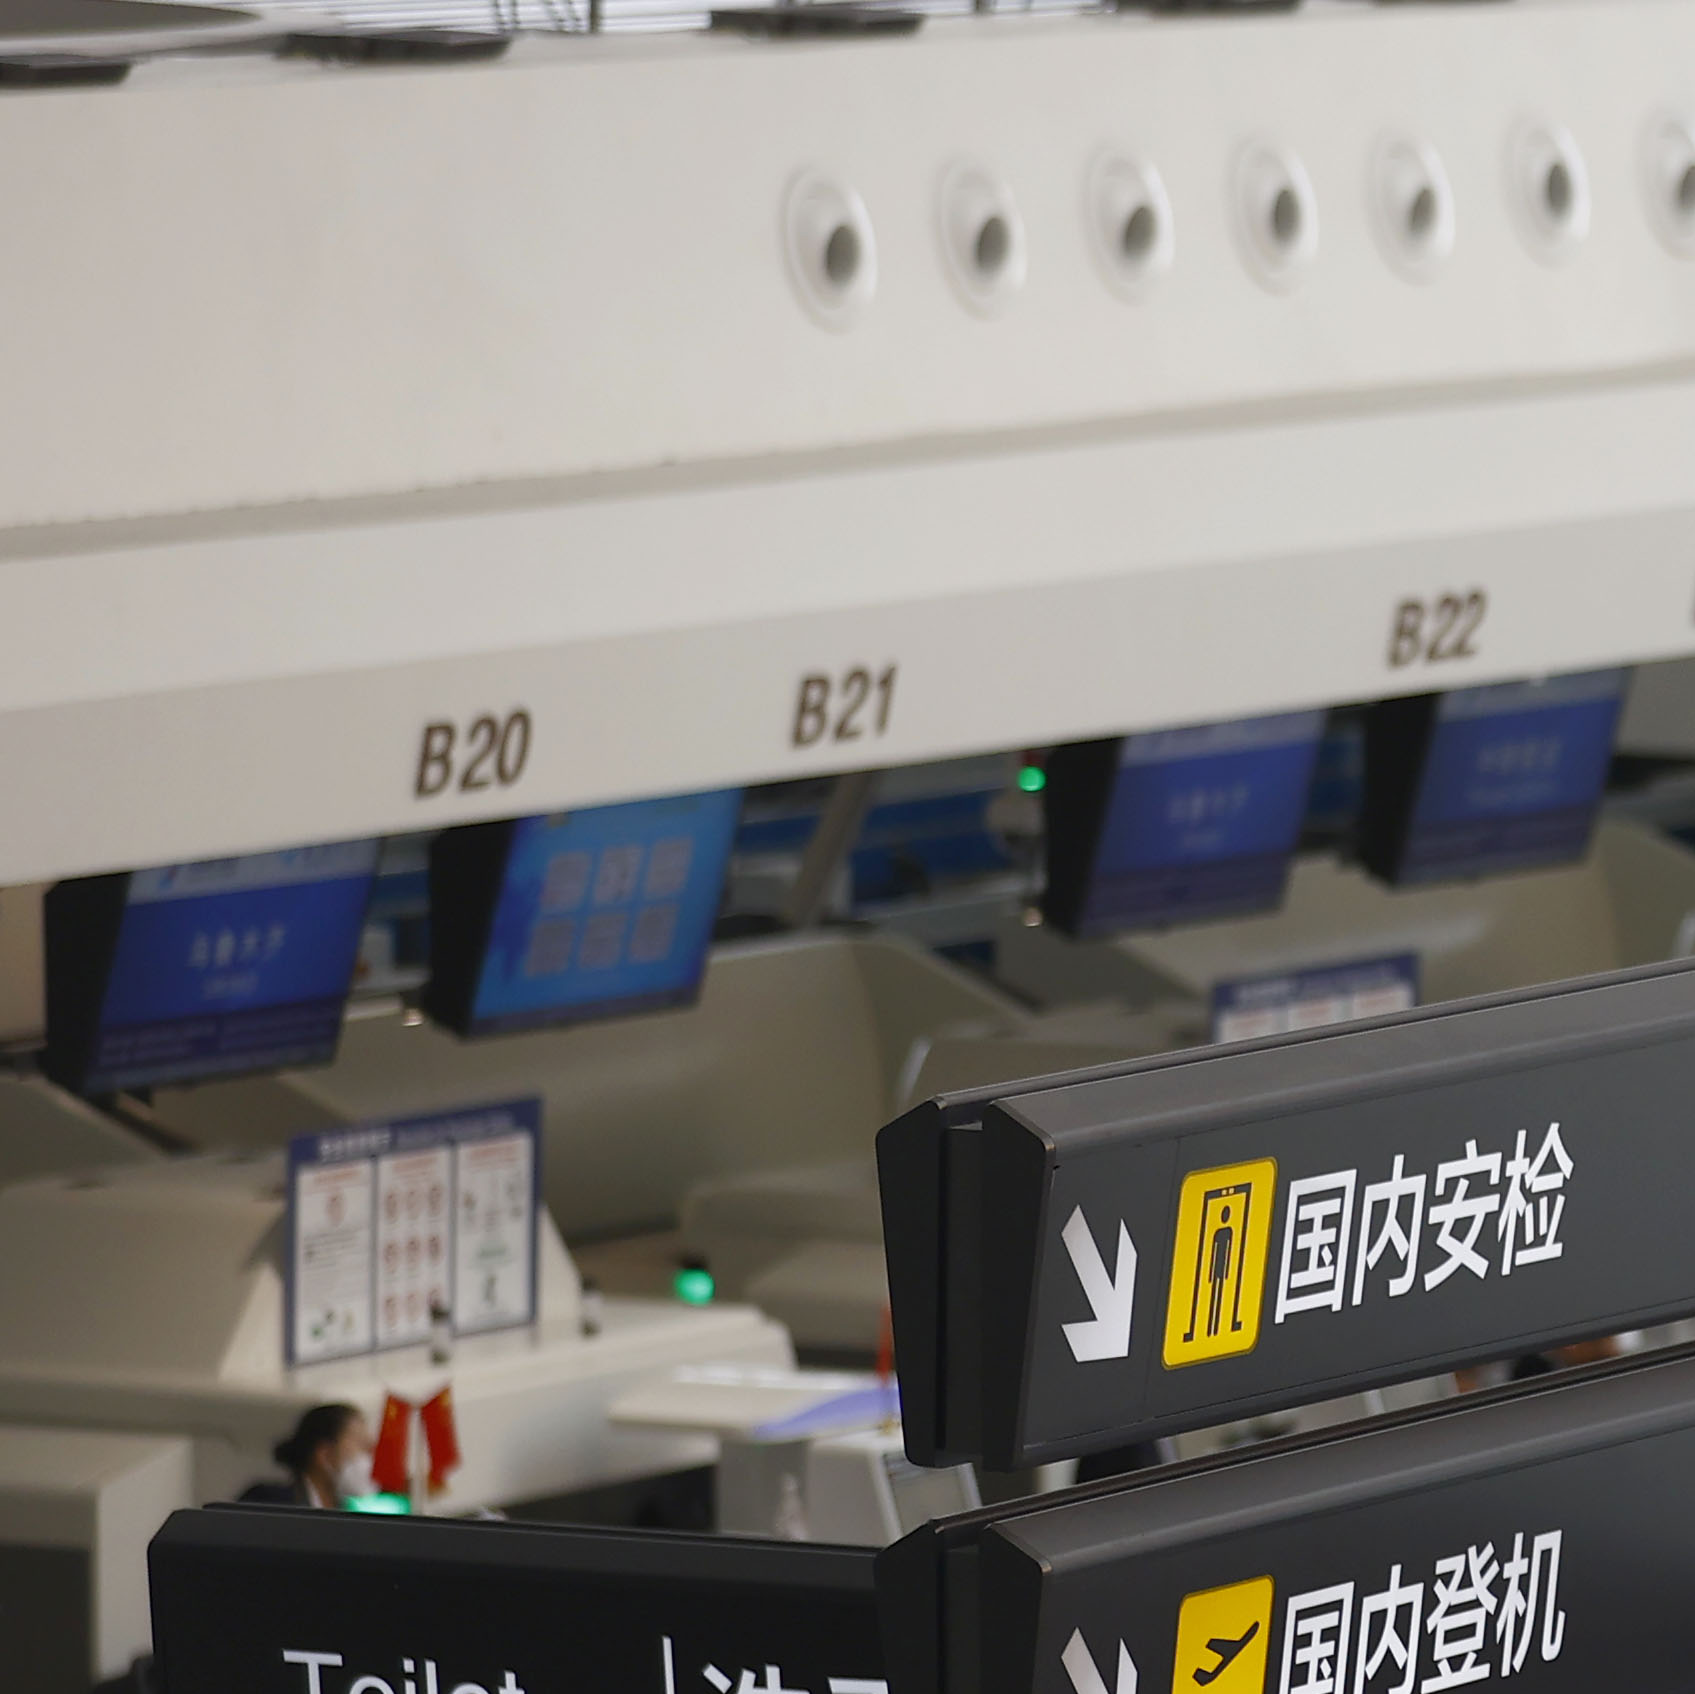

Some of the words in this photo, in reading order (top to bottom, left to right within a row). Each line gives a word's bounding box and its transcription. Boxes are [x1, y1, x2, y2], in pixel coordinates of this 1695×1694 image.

[1385, 587, 1487, 670] B22
[789, 664, 897, 750] B21
[413, 708, 533, 799] B20
[1273, 1121, 1576, 1326] 国内安检
